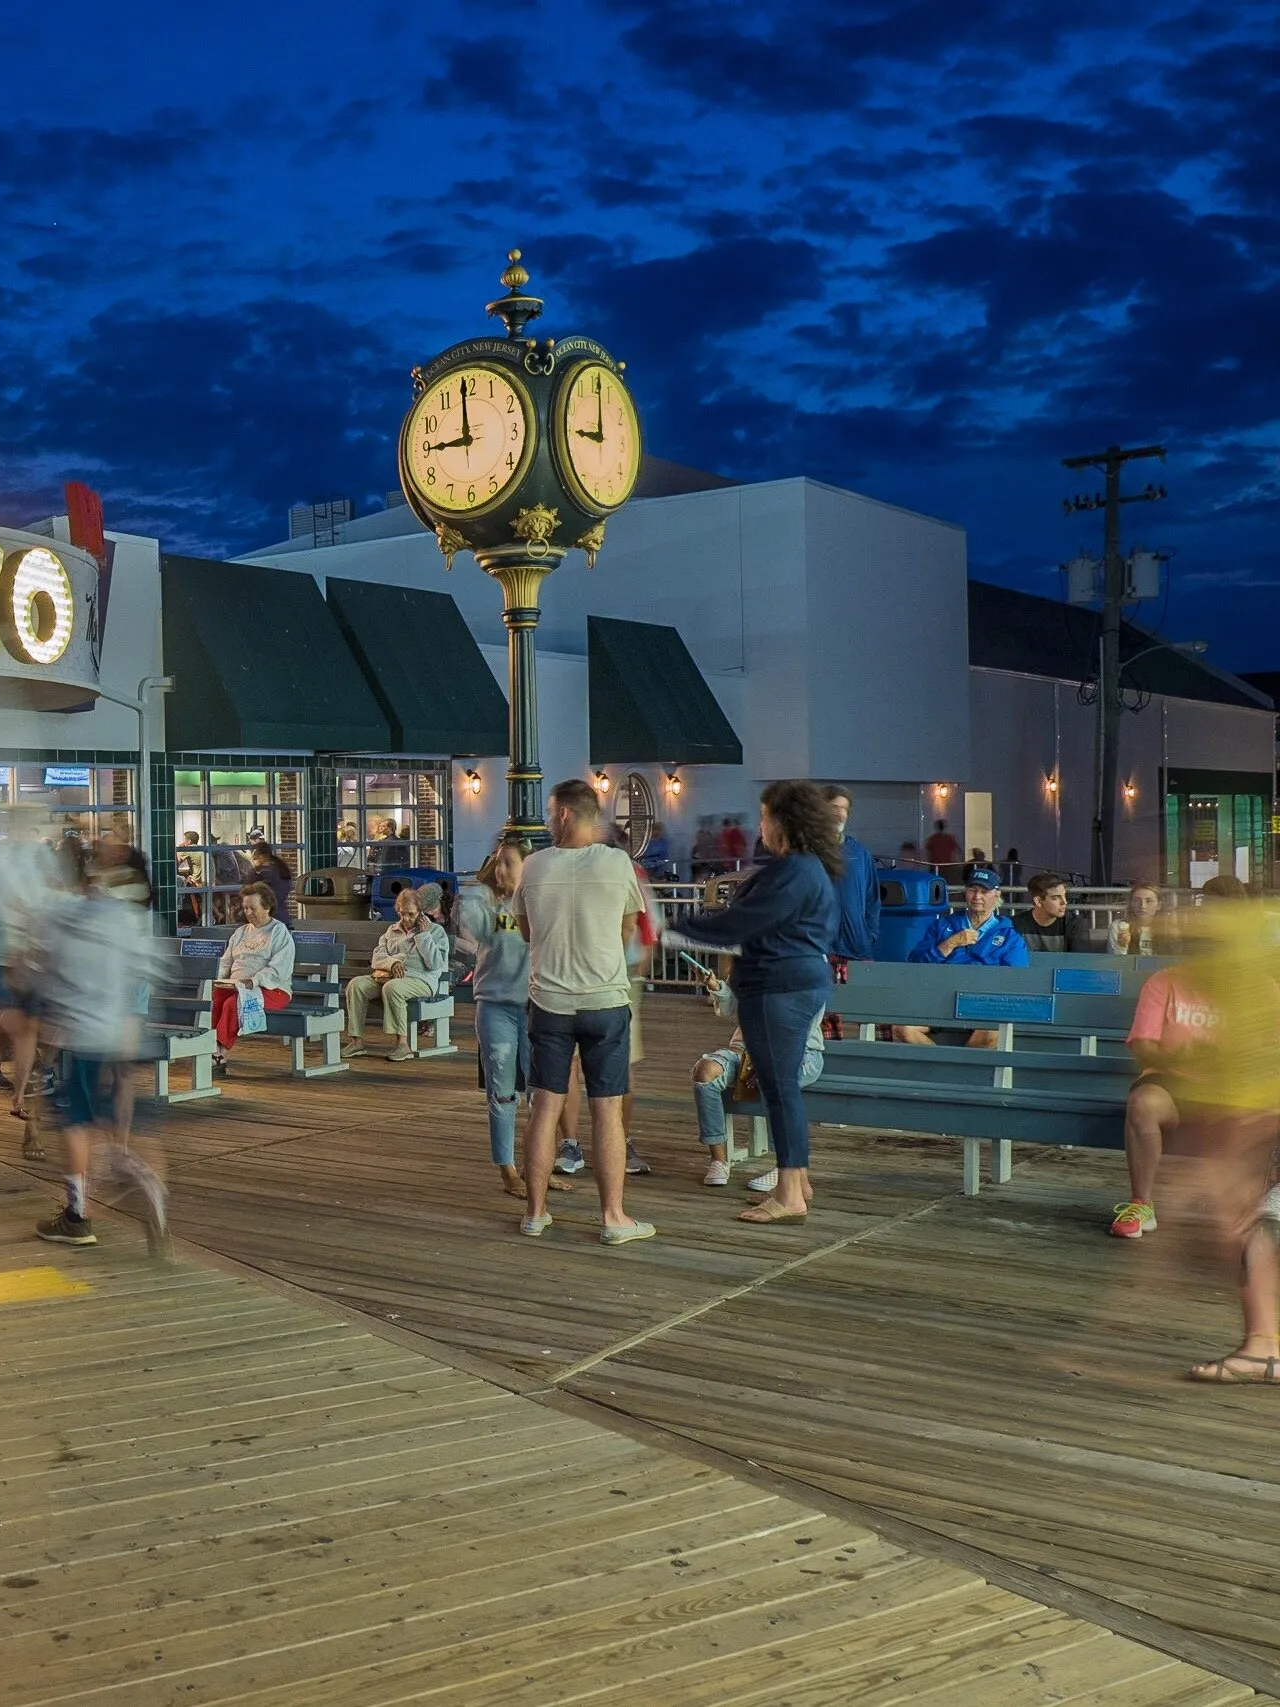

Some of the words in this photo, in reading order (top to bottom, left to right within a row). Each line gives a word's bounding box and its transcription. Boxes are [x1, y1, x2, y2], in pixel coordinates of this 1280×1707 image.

[555, 341, 574, 358] OCEAN
[427, 354, 450, 378] OCEAN
[472, 342, 491, 352] NEW
[492, 342, 522, 358] JERSEY
[488, 380, 495, 399] 1
[440, 391, 451, 411] 11
[506, 395, 515, 414] 2
[424, 415, 438, 435] 10
[510, 422, 518, 441] 3
[422, 441, 431, 459] 9
[506, 451, 515, 470] 4
[426, 467, 436, 486] 8
[488, 475, 498, 494] 5
[445, 483, 455, 502] 7
[467, 484, 476, 503] 6
